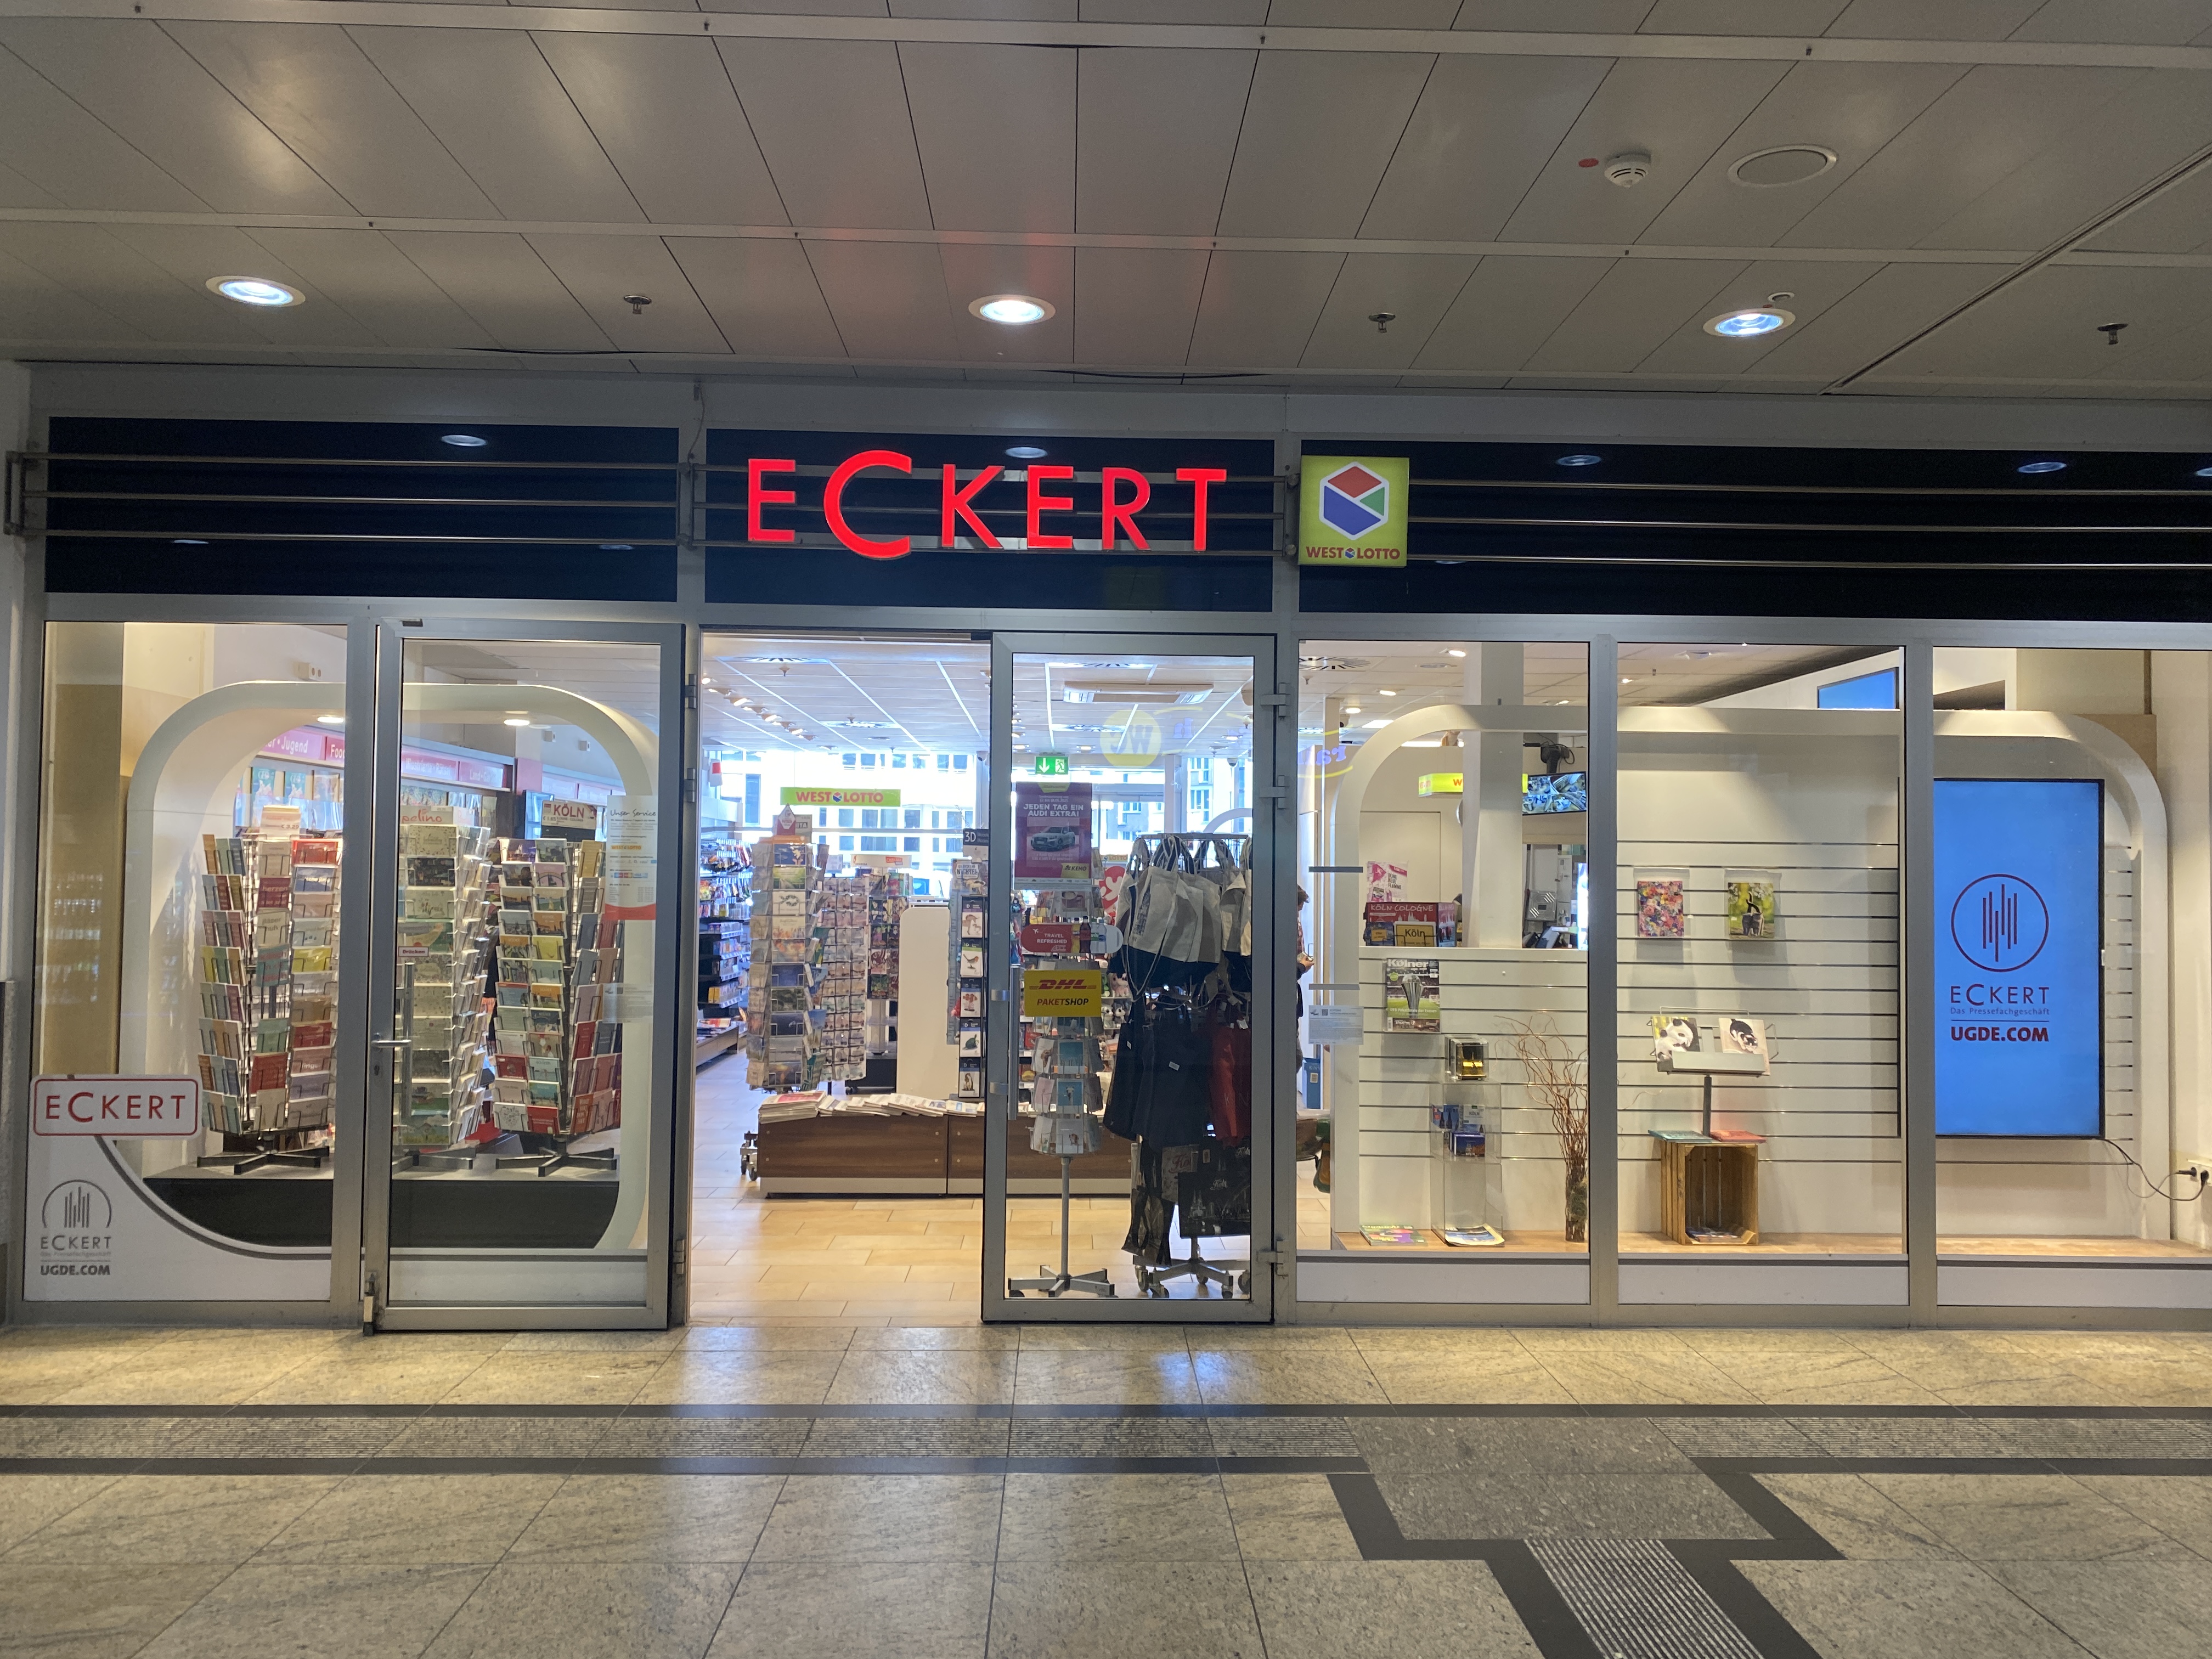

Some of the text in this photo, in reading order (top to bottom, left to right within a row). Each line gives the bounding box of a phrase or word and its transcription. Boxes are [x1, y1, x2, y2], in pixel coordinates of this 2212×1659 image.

[748, 450, 1227, 560] ECKERT
[1306, 546, 1401, 560] WEST LOTTO
[281, 736, 308, 755] Jugend
[795, 791, 883, 803] WEST LOTTO
[554, 803, 584, 819] KÖLN
[632, 808, 657, 817] Service
[964, 831, 977, 842] 3D
[1405, 928, 1426, 937] Köln
[1388, 958, 1429, 968] Kölner
[1039, 979, 1087, 990] DHL
[1950, 983, 2050, 1006] ECKERT
[1970, 1007, 2050, 1017] Pressefachgeschäft
[1951, 1026, 2049, 1042] UGDE.COM
[45, 1091, 186, 1122] ECKERT
[41, 1235, 111, 1251] ECKERT
[41, 1265, 111, 1276] UGDE.COM
